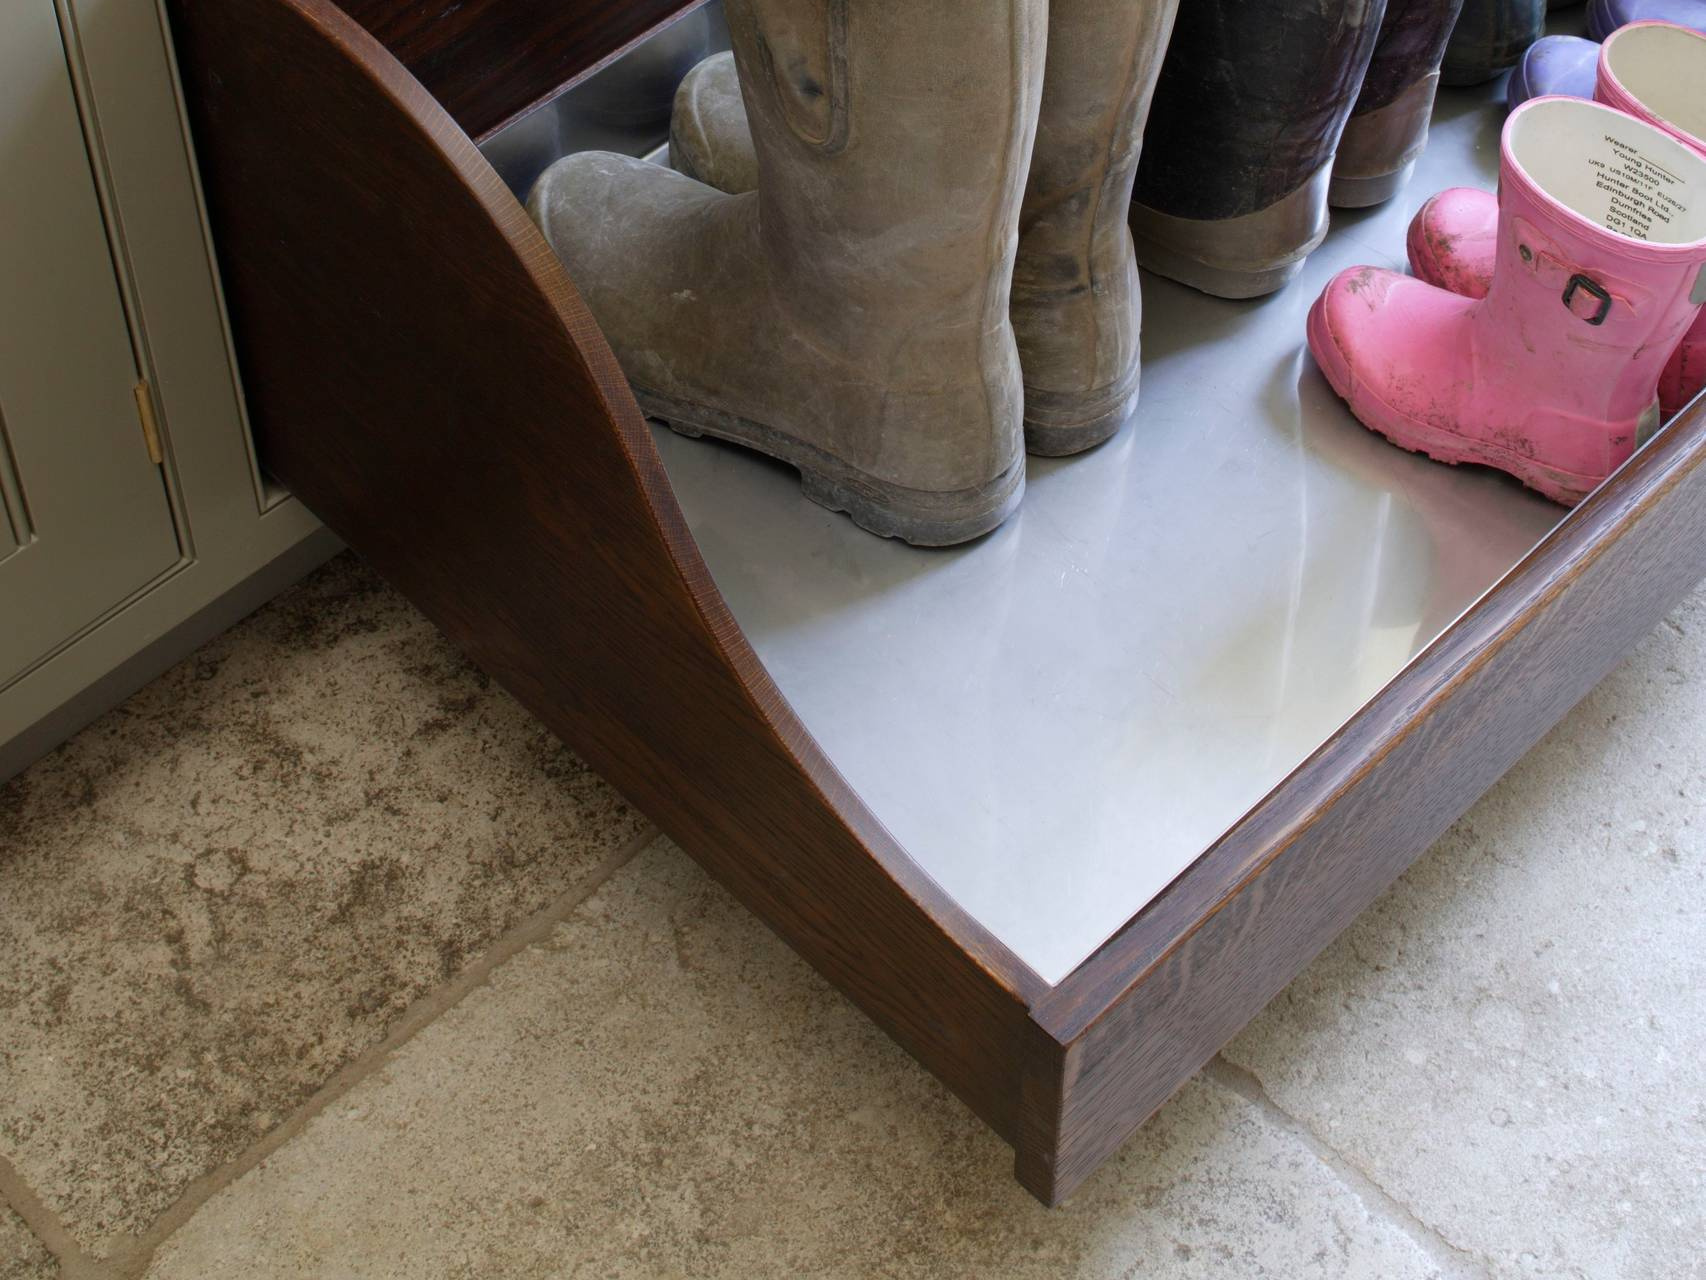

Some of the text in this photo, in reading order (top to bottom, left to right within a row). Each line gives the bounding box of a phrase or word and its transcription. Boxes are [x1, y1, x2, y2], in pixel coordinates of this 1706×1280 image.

[1605, 135, 1637, 154] Wearer
[1589, 159, 1605, 168] UK9
[1613, 148, 1675, 185] Young Hunter
[1624, 163, 1660, 186] W23500
[1597, 172, 1629, 189] Hunter
[1632, 188, 1653, 202] Boot
[1596, 181, 1670, 223] Edinburgh Road
[1611, 197, 1652, 223] Dumfries
[1606, 214, 1625, 227] DG1
[1630, 226, 1647, 240] 1QA
[1609, 206, 1649, 231] Scotland
